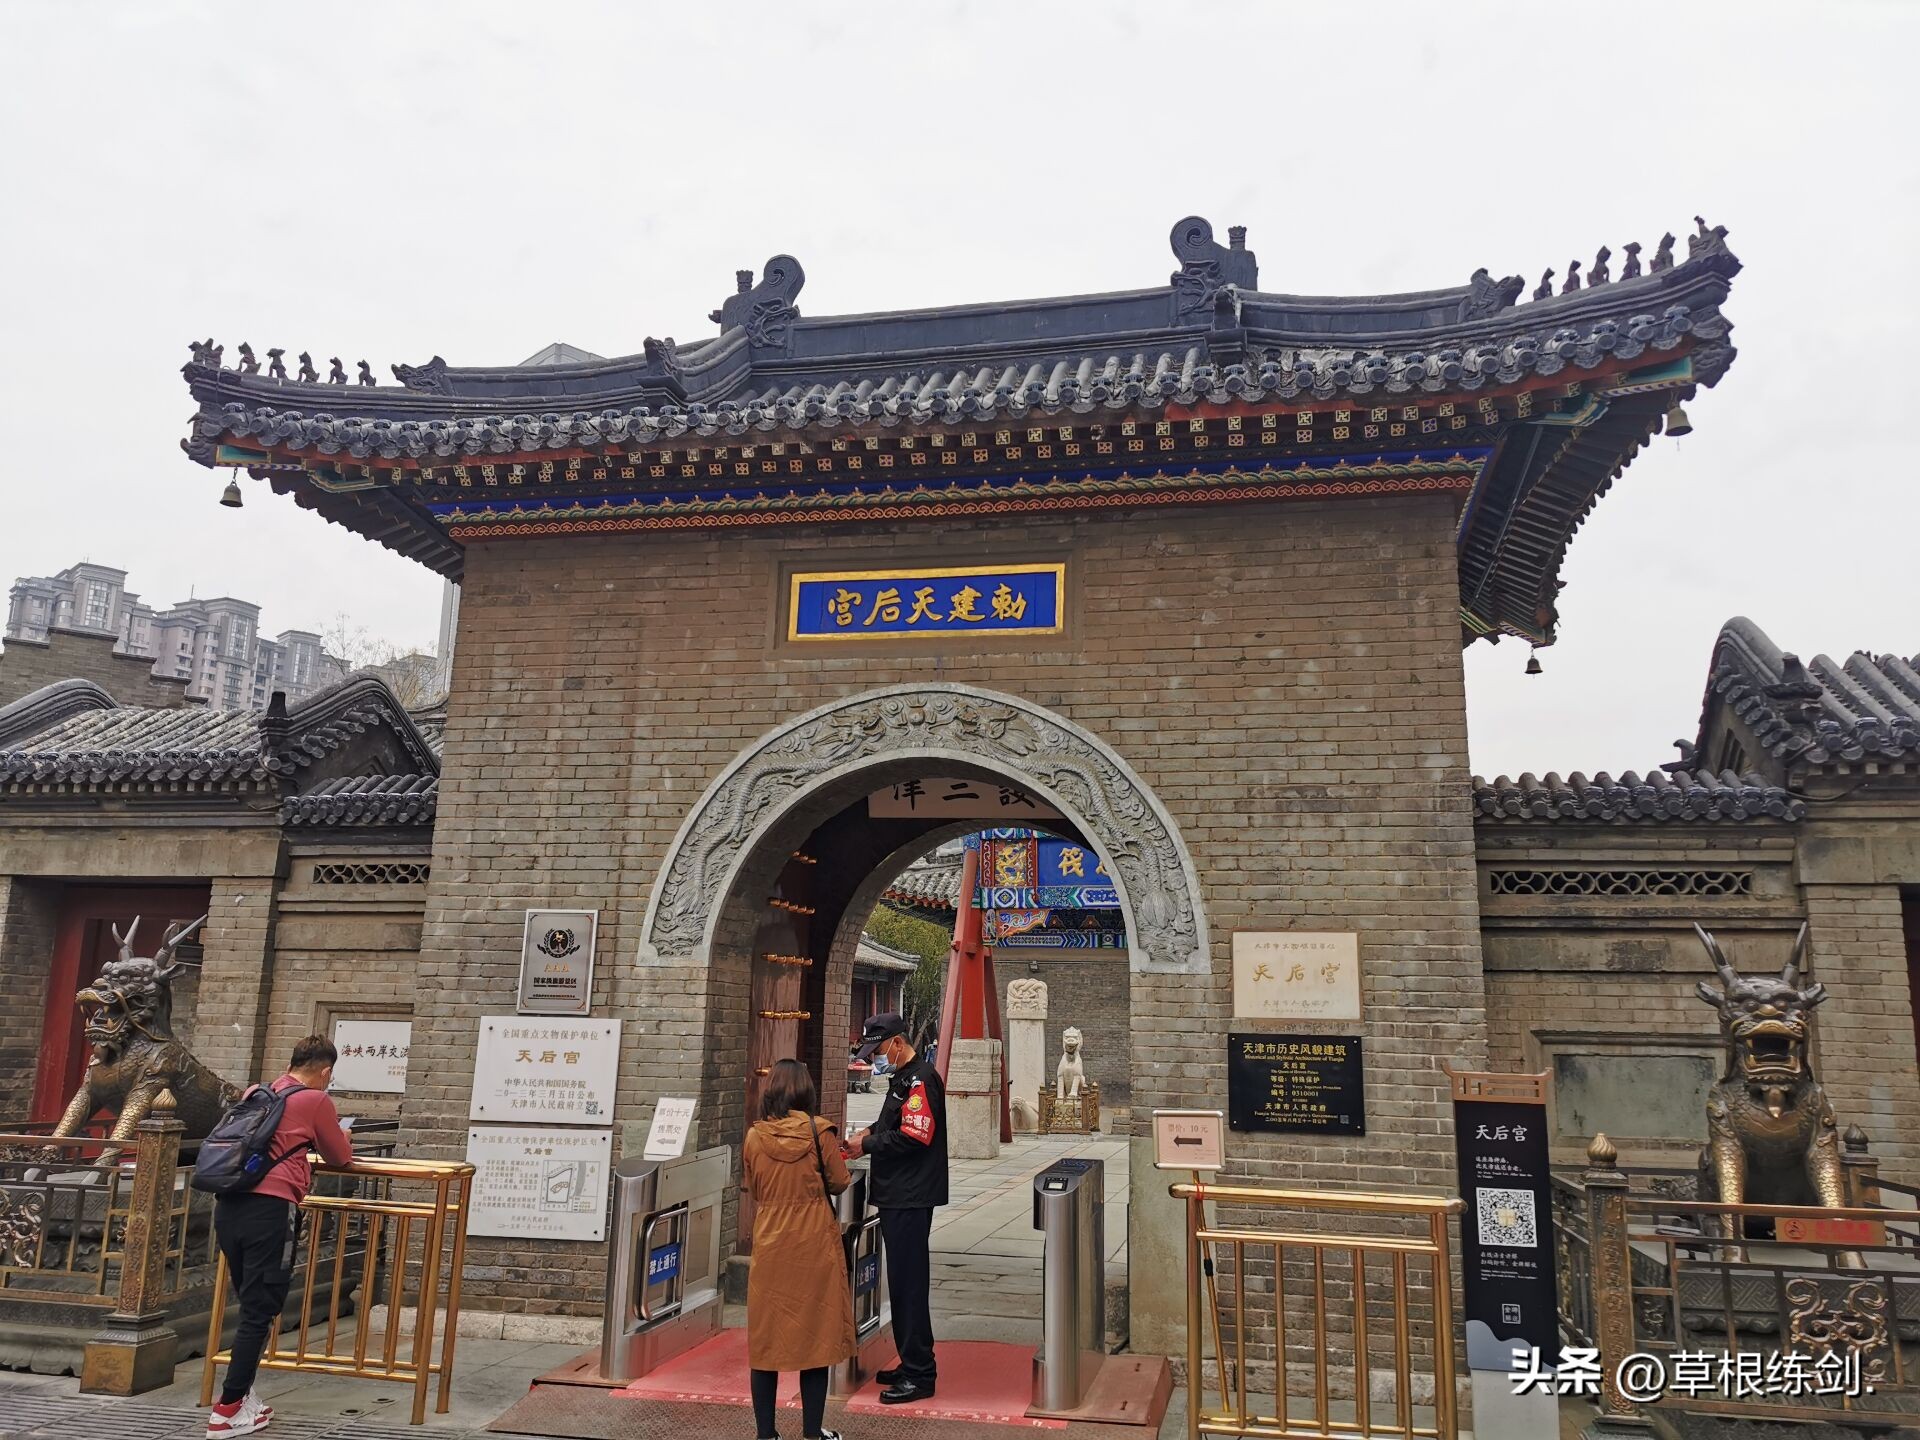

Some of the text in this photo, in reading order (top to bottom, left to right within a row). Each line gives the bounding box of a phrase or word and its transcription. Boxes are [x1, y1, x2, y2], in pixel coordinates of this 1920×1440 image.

[1253, 962, 1341, 984] 天后宫
[503, 1028, 599, 1041] 全国重点文物保护单位
[1242, 1042, 1347, 1056] 天津市历史风貌建筑
[515, 1049, 580, 1064] 天后宫
[504, 1078, 586, 1089] 中华人民共和国国务院
[1265, 1102, 1327, 1111] 天津市人民政府
[657, 1124, 682, 1135] 售票处
[1475, 1124, 1528, 1142] 天后宫
[649, 1252, 677, 1276] 禁止通行
